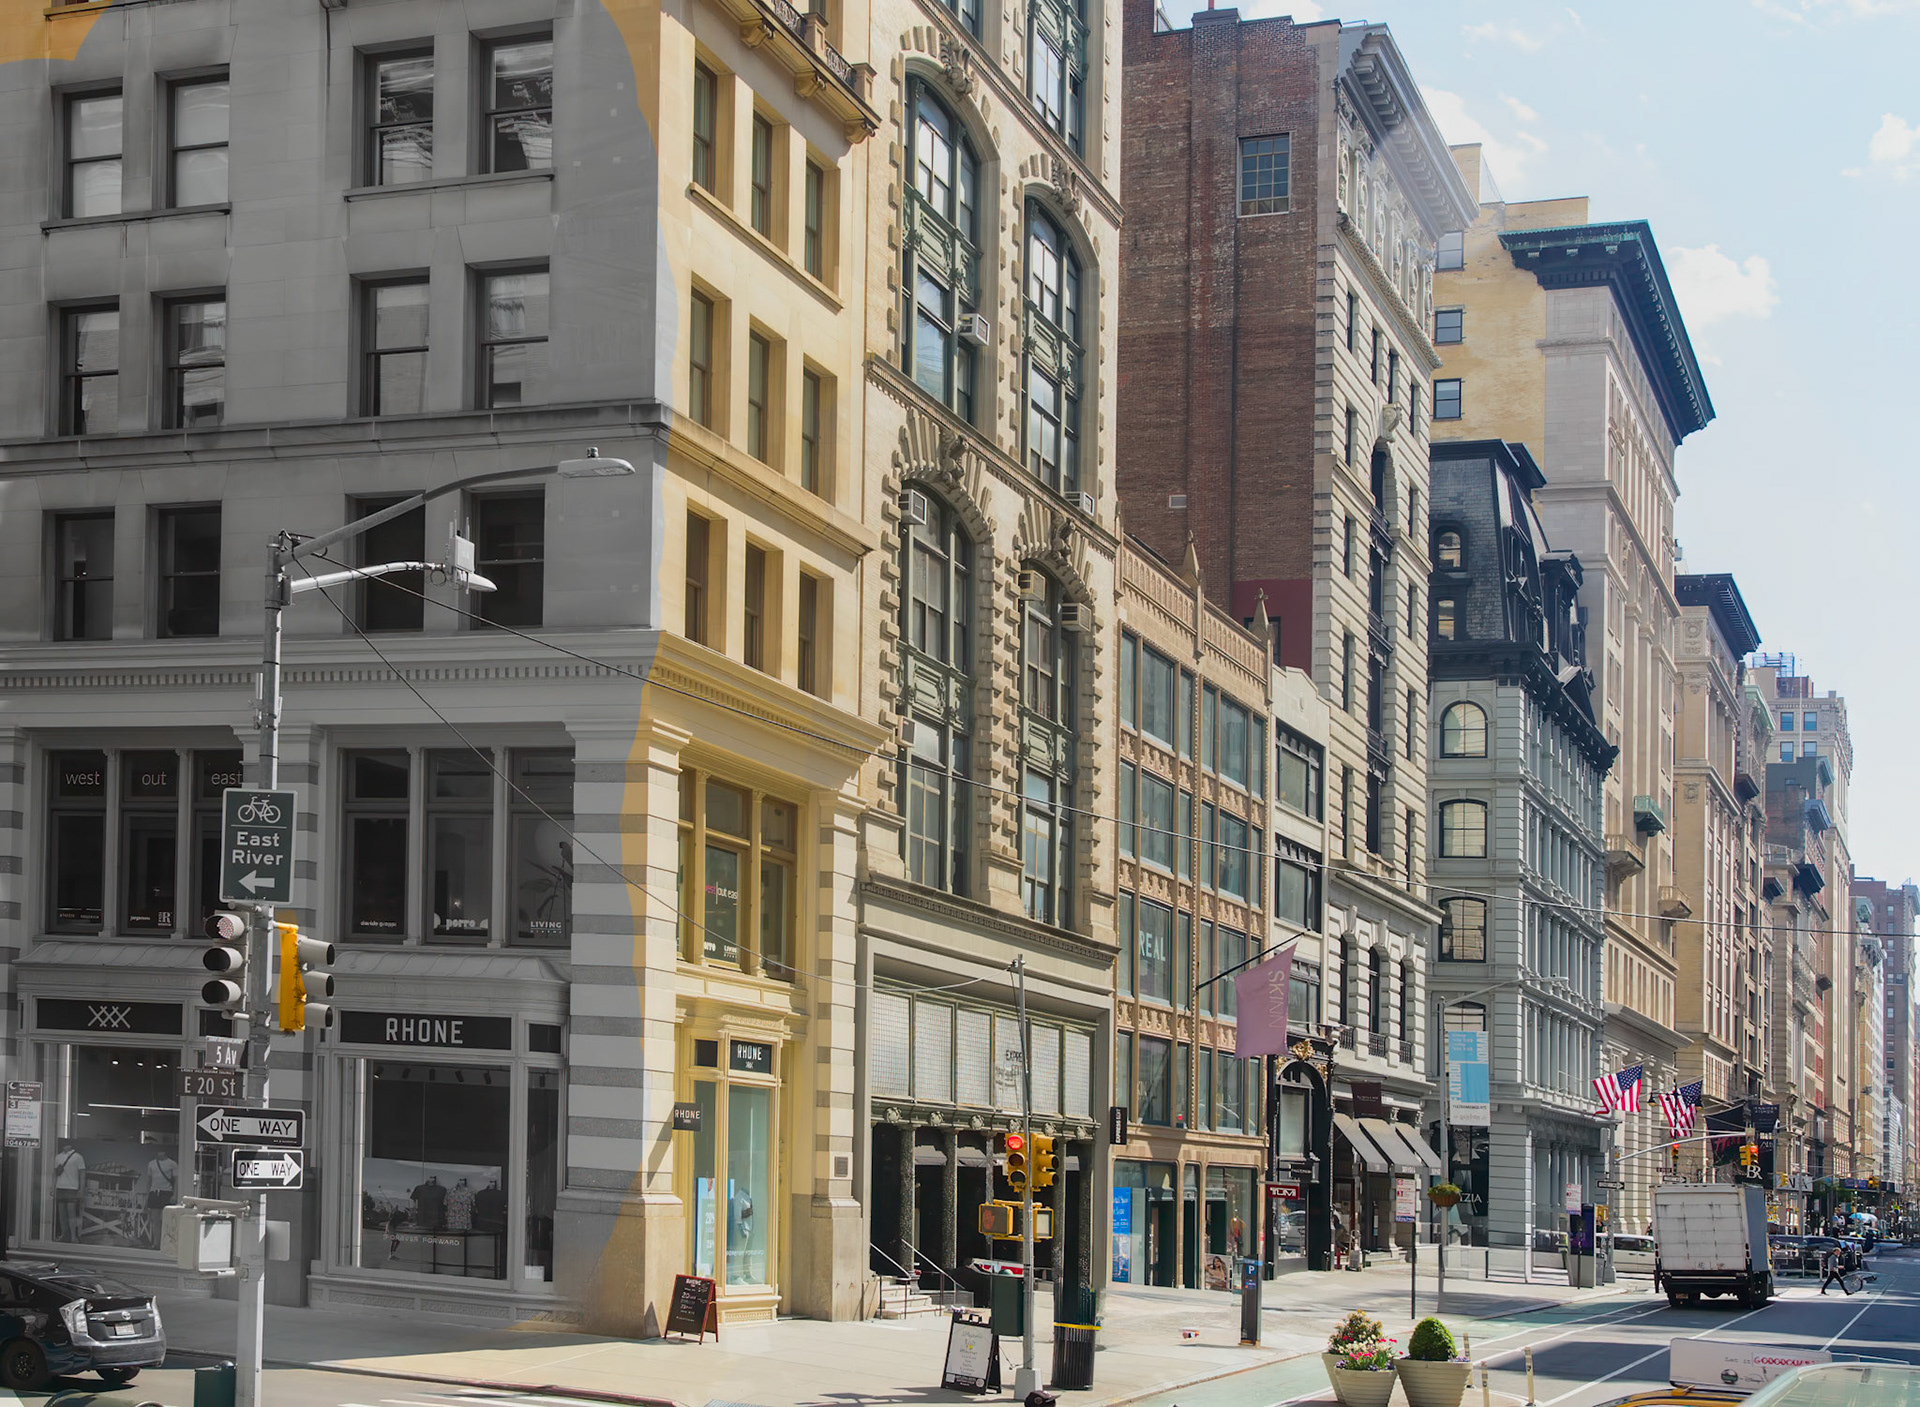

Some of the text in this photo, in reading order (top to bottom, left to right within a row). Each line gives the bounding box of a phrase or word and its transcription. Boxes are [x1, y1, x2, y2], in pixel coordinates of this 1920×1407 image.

[66, 771, 100, 785] west
[141, 771, 167, 785] out
[236, 831, 280, 847] East
[232, 849, 284, 865] River
[530, 920, 562, 929] LIVING
[1139, 930, 1166, 962] REAL
[386, 1017, 463, 1044] RHONE
[216, 1045, 237, 1065] 5 Av
[737, 1043, 762, 1061] RHONE
[184, 1075, 236, 1096] E 20 St
[674, 1109, 701, 1120] RHONE
[210, 1117, 293, 1136] ONE WAY
[239, 1161, 293, 1177] ONE WAY
